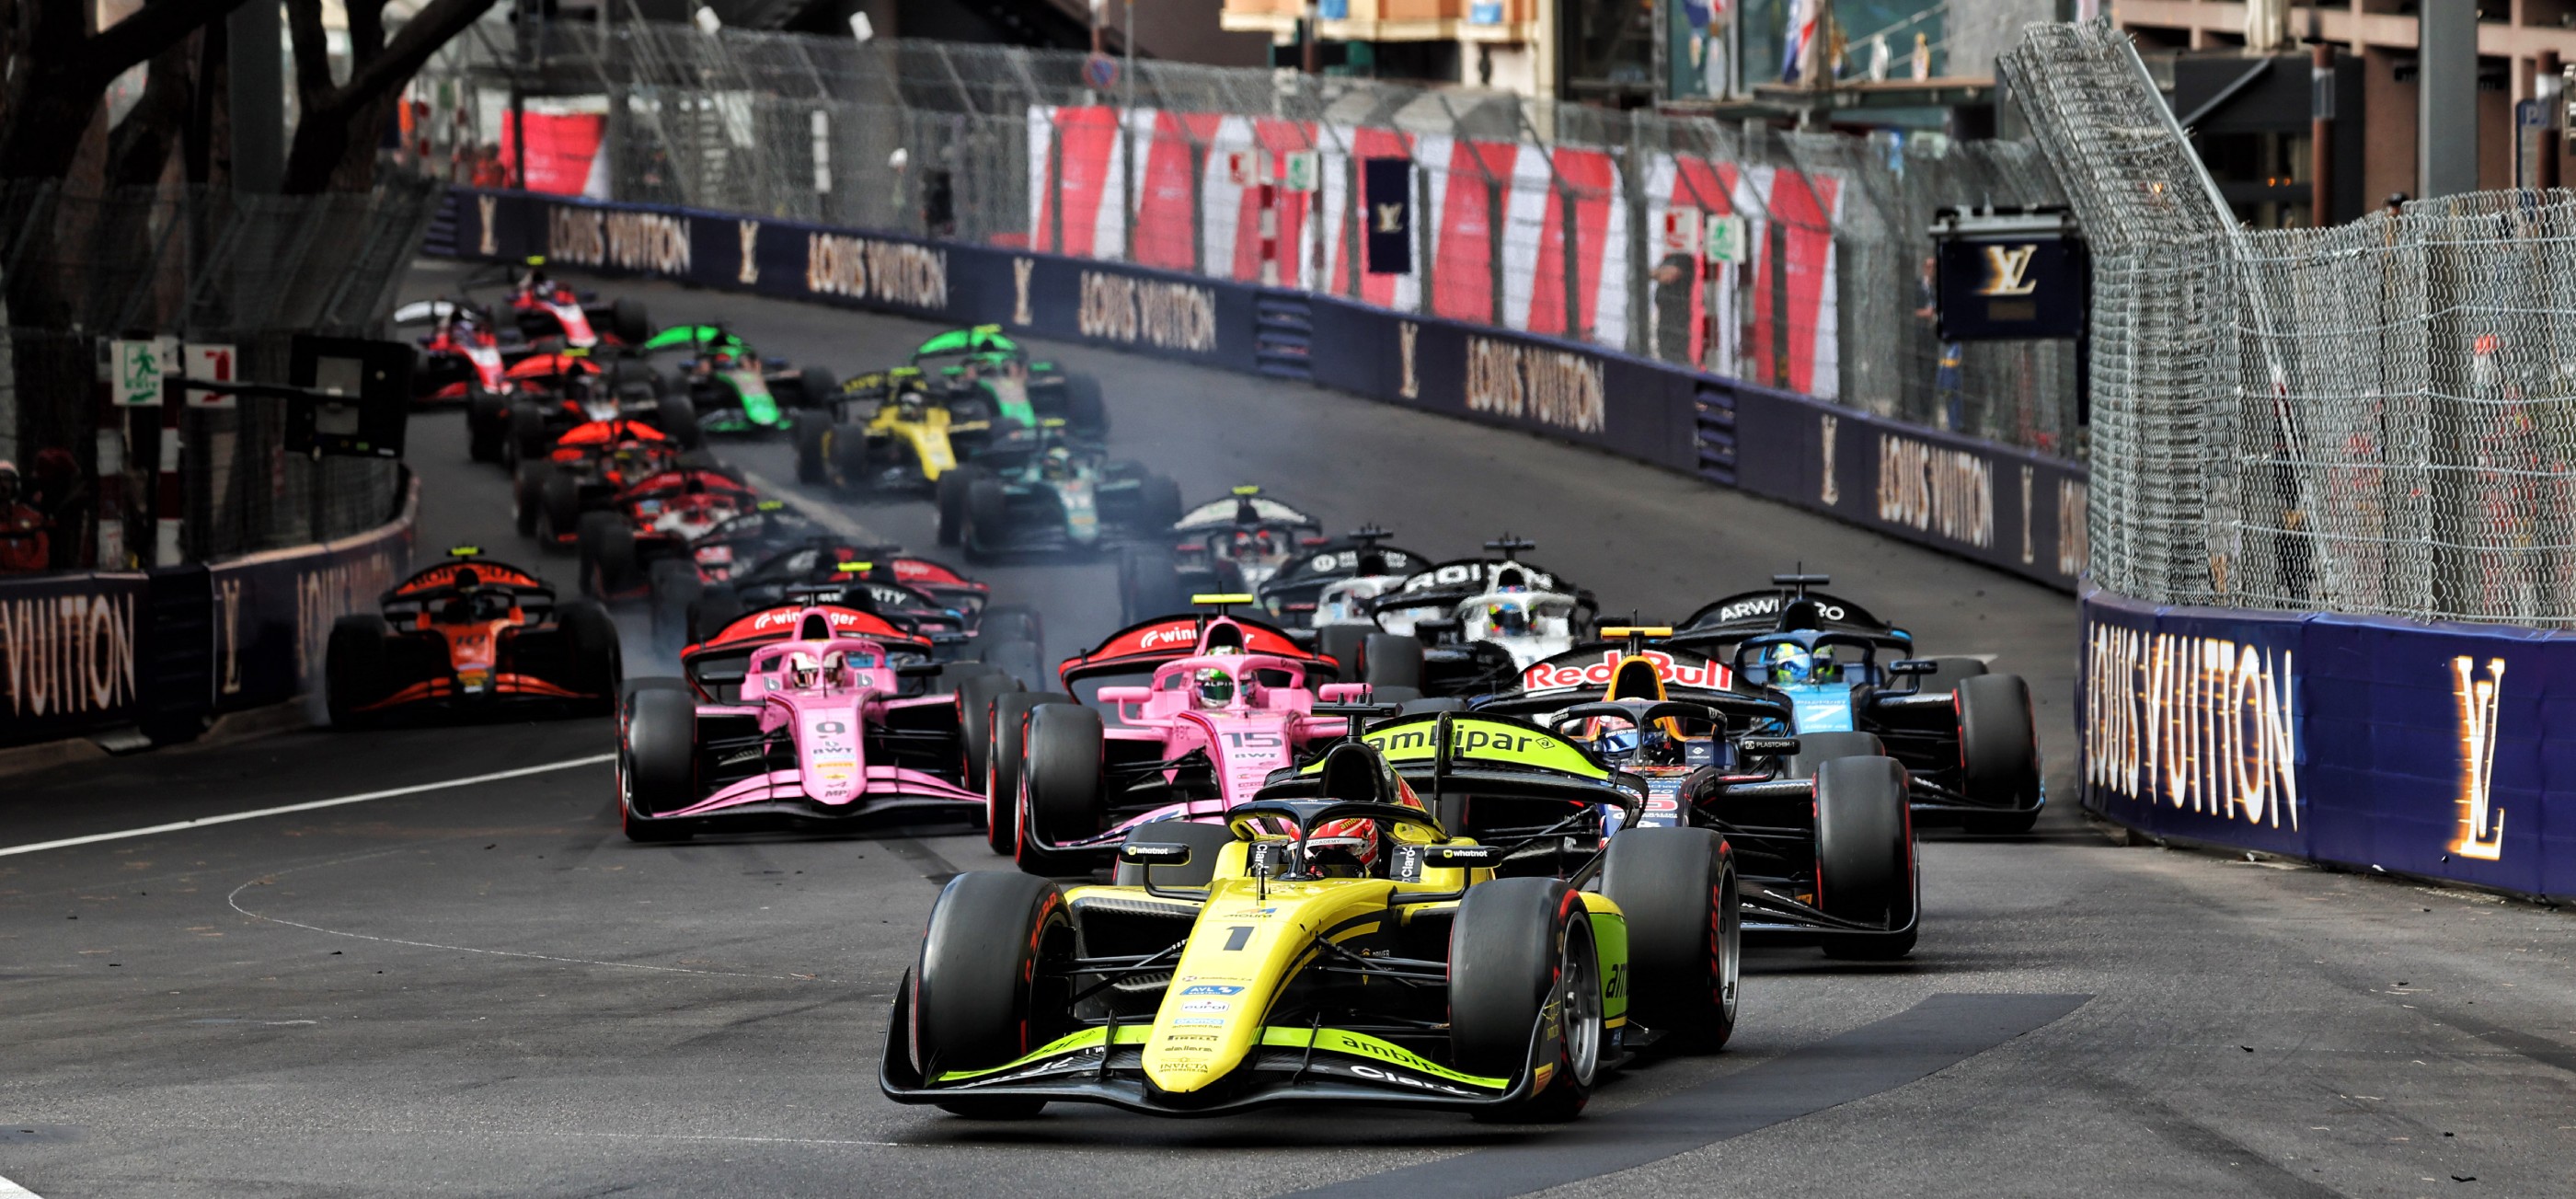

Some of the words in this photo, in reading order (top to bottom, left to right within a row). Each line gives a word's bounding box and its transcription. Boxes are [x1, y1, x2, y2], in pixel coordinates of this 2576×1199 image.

[806, 232, 866, 298] LOUIS
[867, 238, 948, 309] VUITTON
[1078, 270, 1137, 343] LOUIS
[1138, 277, 1216, 352] VUITTON
[1466, 335, 1524, 417] LOUIS
[1524, 344, 1604, 434] VUITTON
[1877, 433, 1929, 532] LOUIS
[1930, 445, 1995, 549] VUITTON
[0, 592, 136, 719] VUITTON
[1524, 649, 1623, 691] Red
[1640, 649, 1732, 691] Bull
[815, 721, 846, 739] 9
[1804, 705, 1846, 722] 7
[2086, 619, 2140, 801] LOUIS
[2142, 631, 2298, 833] VUITTON
[1221, 732, 1282, 748] 15
[1367, 725, 1533, 754] amipar
[1137, 847, 1168, 855] whatnot
[1453, 849, 1488, 858] whatnot
[1223, 926, 1256, 951] 1
